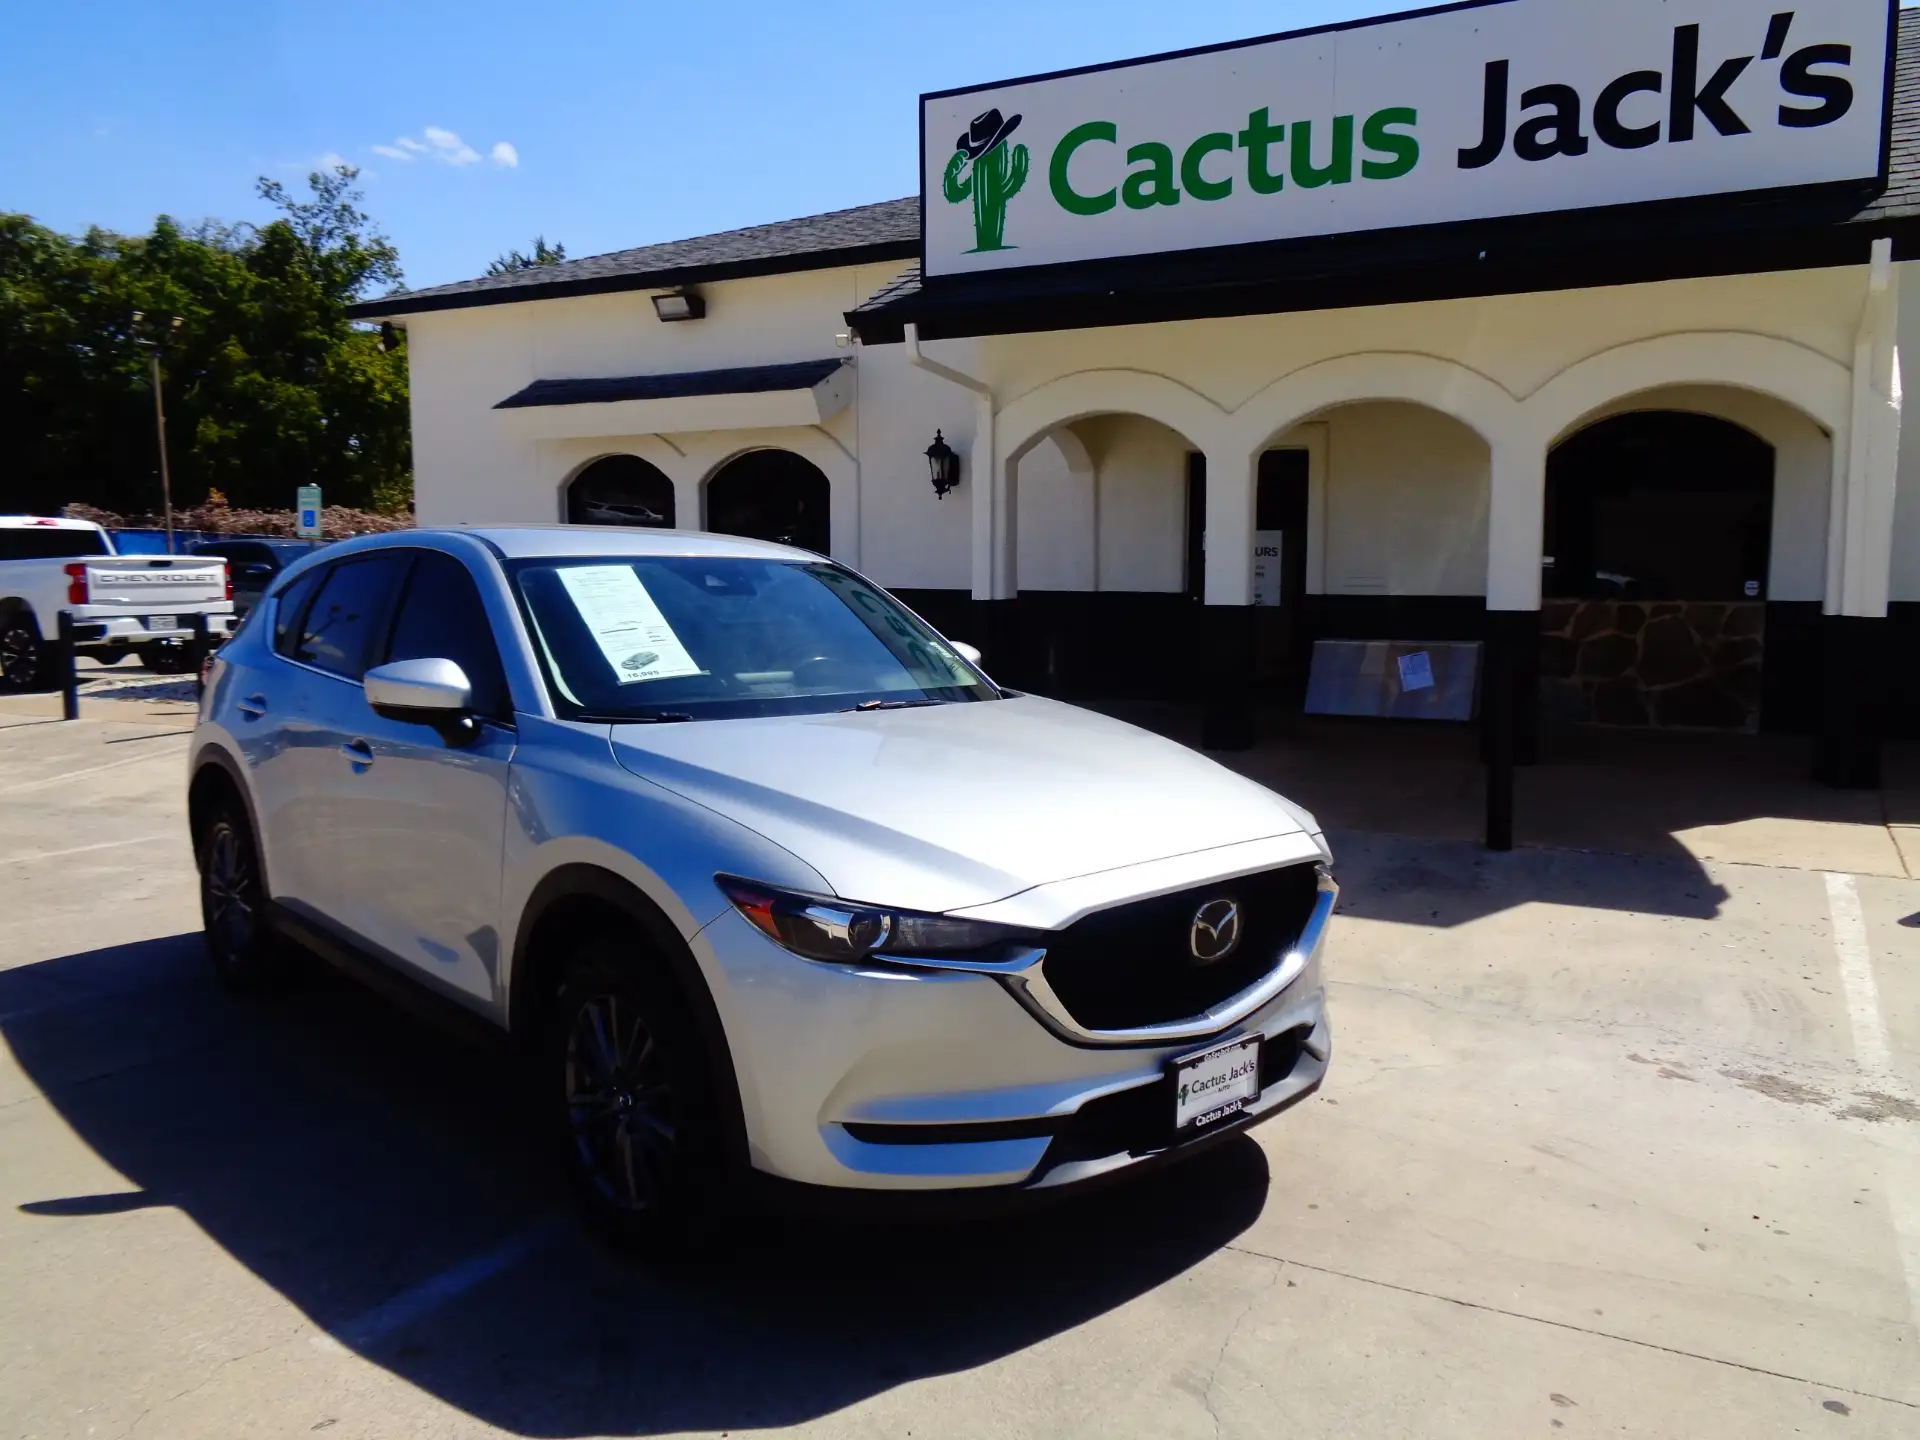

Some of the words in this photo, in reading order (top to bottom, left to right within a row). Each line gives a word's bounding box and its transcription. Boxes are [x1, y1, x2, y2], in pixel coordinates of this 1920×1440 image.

[1048, 104, 1420, 216] Cactus
[1456, 10, 1855, 170] Jack's
[1254, 546, 1279, 557] URS
[101, 574, 216, 583] CHEVROLET
[1191, 1073, 1227, 1094] Cactus
[1229, 1059, 1255, 1081] Jack's
[1217, 1084, 1231, 1093] AUTO
[1196, 1111, 1222, 1127] Cactus
[1222, 1099, 1242, 1117] Jack's
